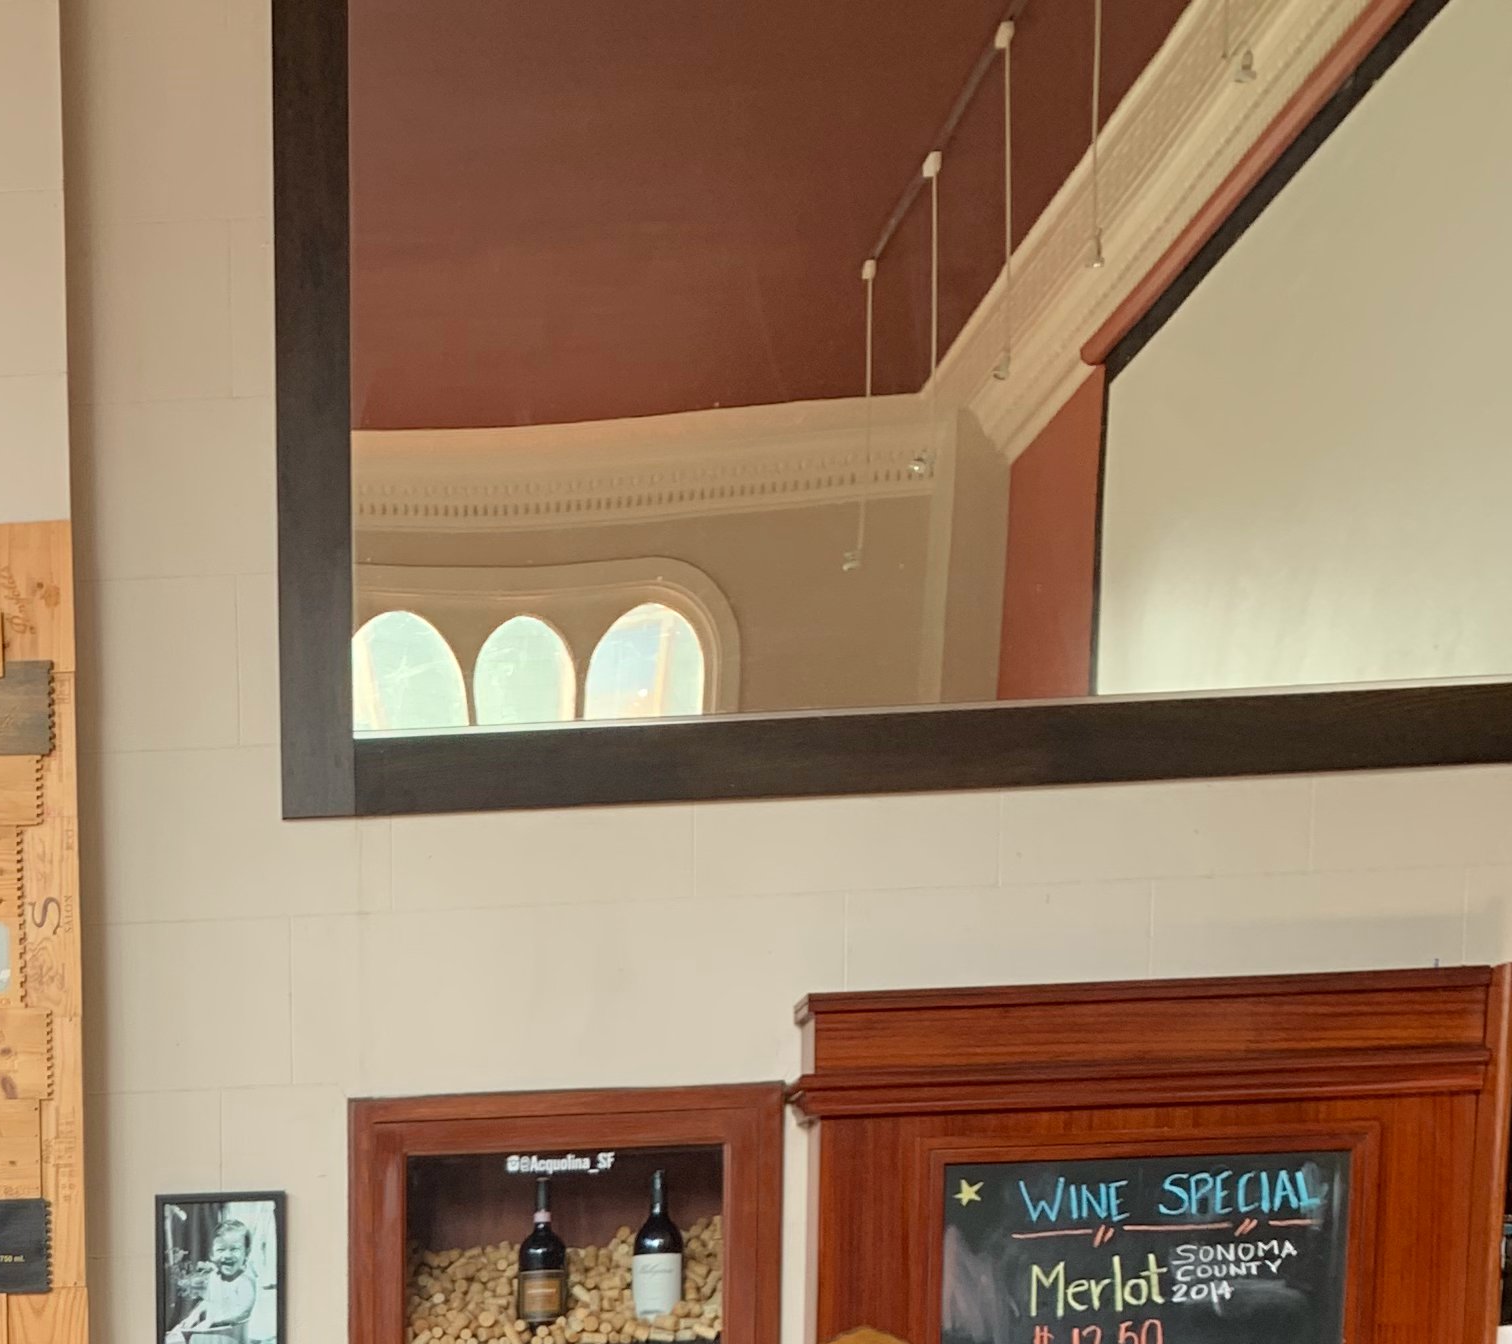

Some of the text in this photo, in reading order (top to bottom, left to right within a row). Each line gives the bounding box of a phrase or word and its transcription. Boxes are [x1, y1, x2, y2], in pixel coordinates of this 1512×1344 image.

[65, 894, 73, 934] SALON
[519, 1151, 616, 1175] @Acquolina_SF
[1019, 1169, 1322, 1222] WINE SPECIAL
[0, 1254, 13, 1263] 750
[1170, 1240, 1298, 1265] SONOMA
[1174, 1258, 1283, 1282] COUNTY
[1029, 1253, 1168, 1319] Merlot
[1170, 1282, 1235, 1304] 2014
